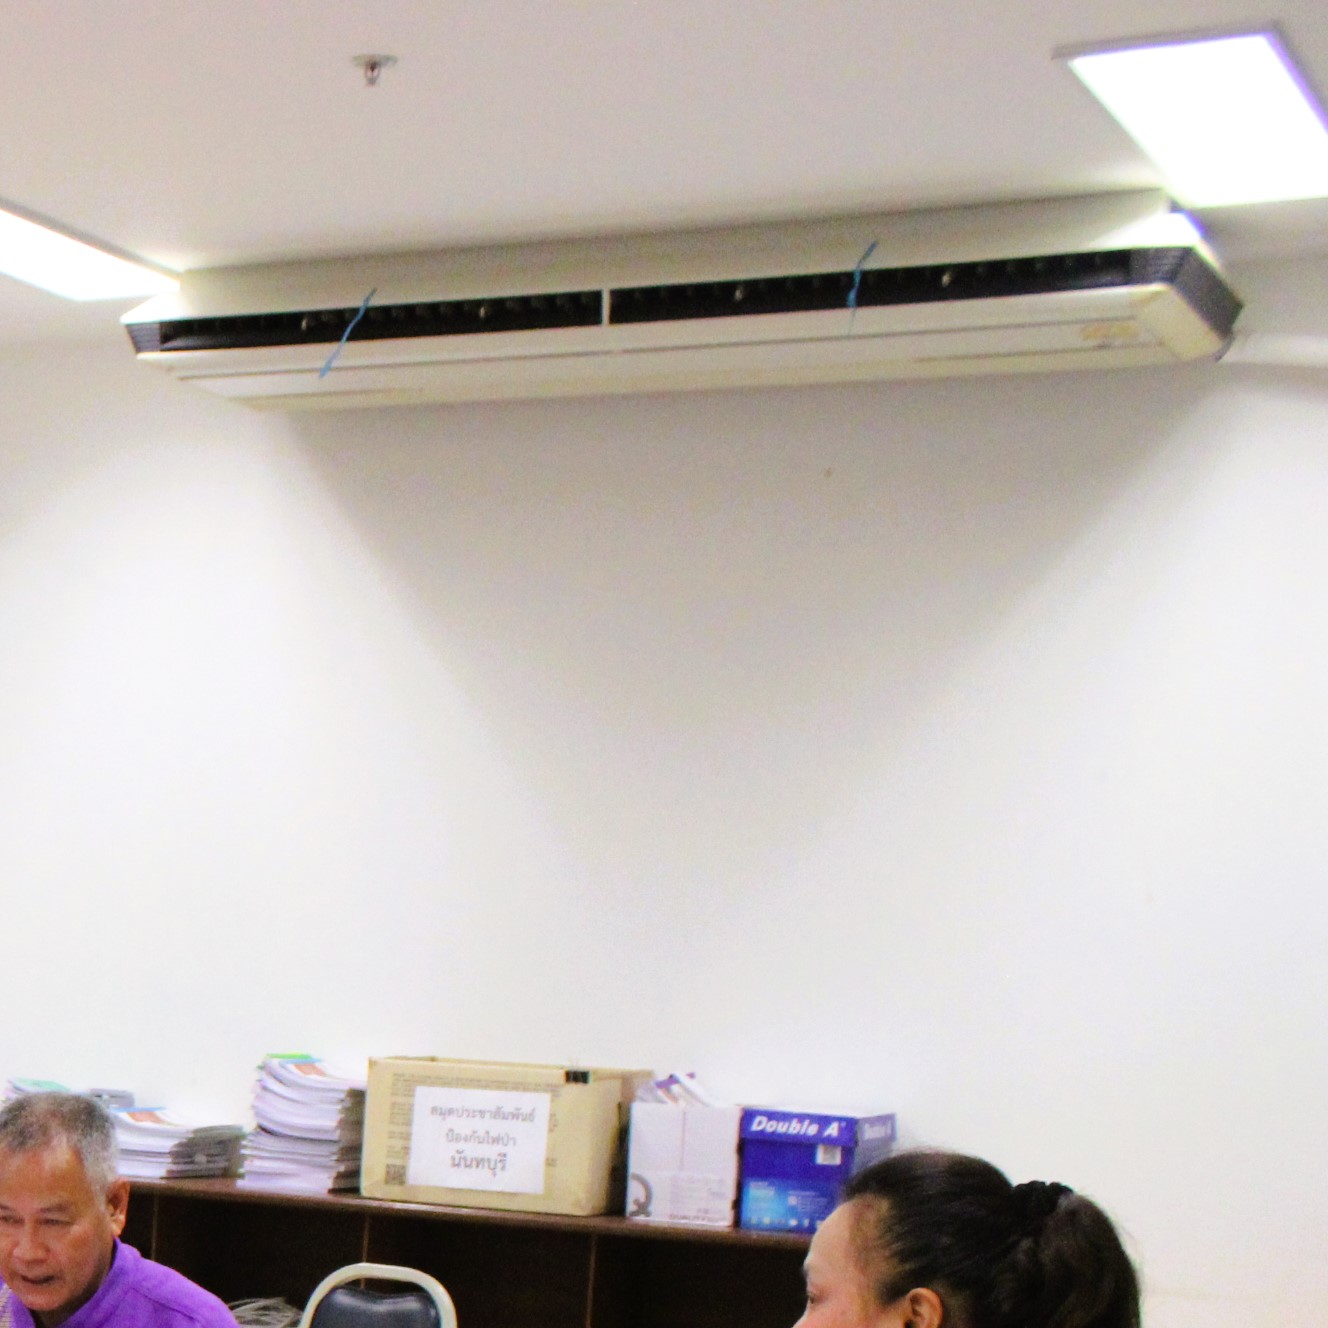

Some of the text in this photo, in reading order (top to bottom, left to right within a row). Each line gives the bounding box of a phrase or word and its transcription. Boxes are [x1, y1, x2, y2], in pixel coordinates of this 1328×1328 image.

[430, 1102, 536, 1123] สมุดประชาสัมพันธ์
[750, 1115, 819, 1136] Double
[823, 1121, 841, 1138] A
[450, 1150, 508, 1178] นันทบุรี
